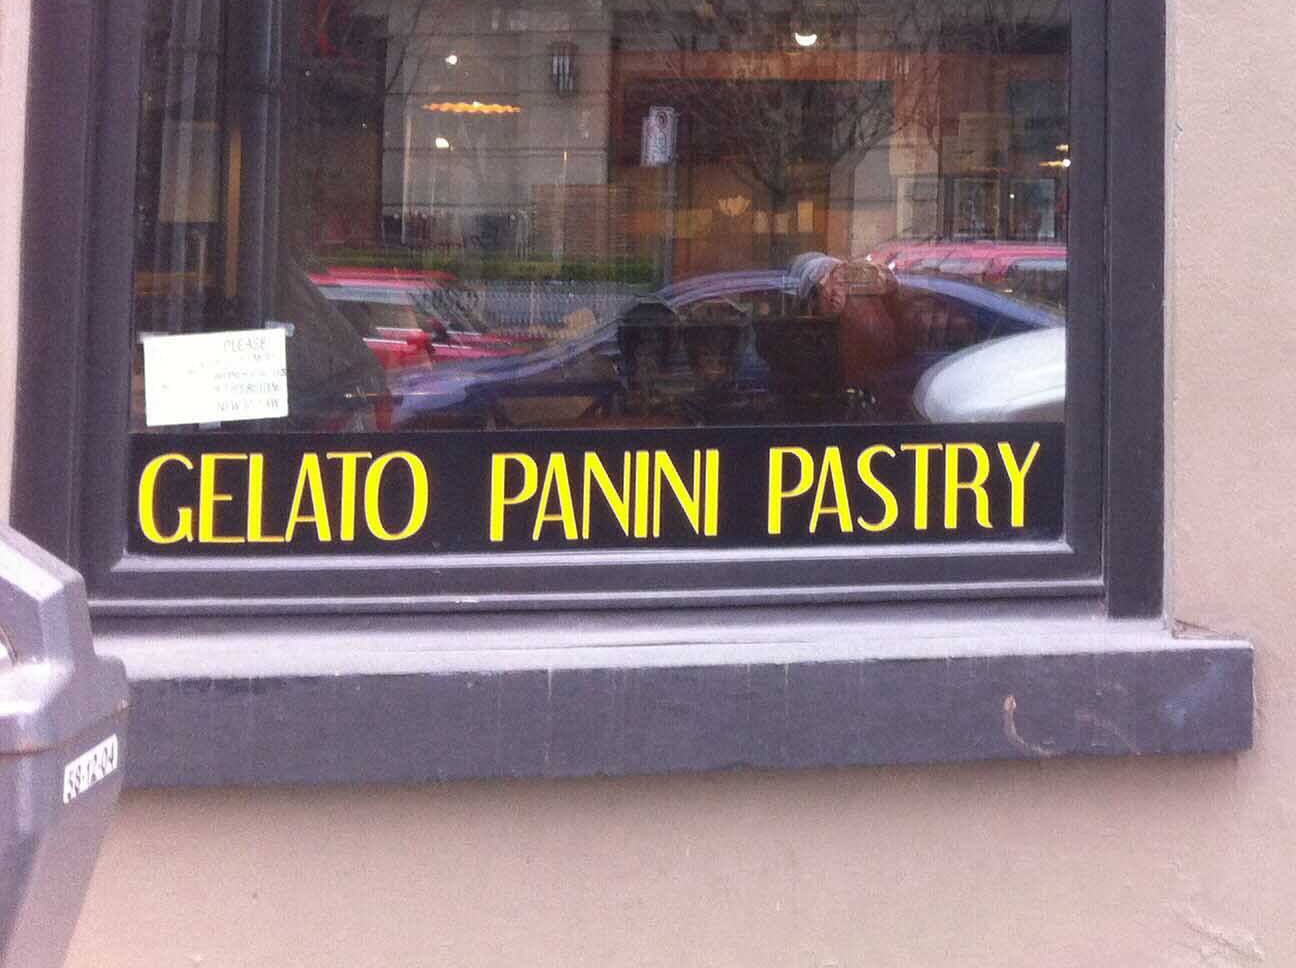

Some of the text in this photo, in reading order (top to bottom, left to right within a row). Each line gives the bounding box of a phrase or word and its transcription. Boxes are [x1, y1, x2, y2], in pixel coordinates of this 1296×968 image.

[138, 441, 1041, 544] GELATO PANINI PASTRY
